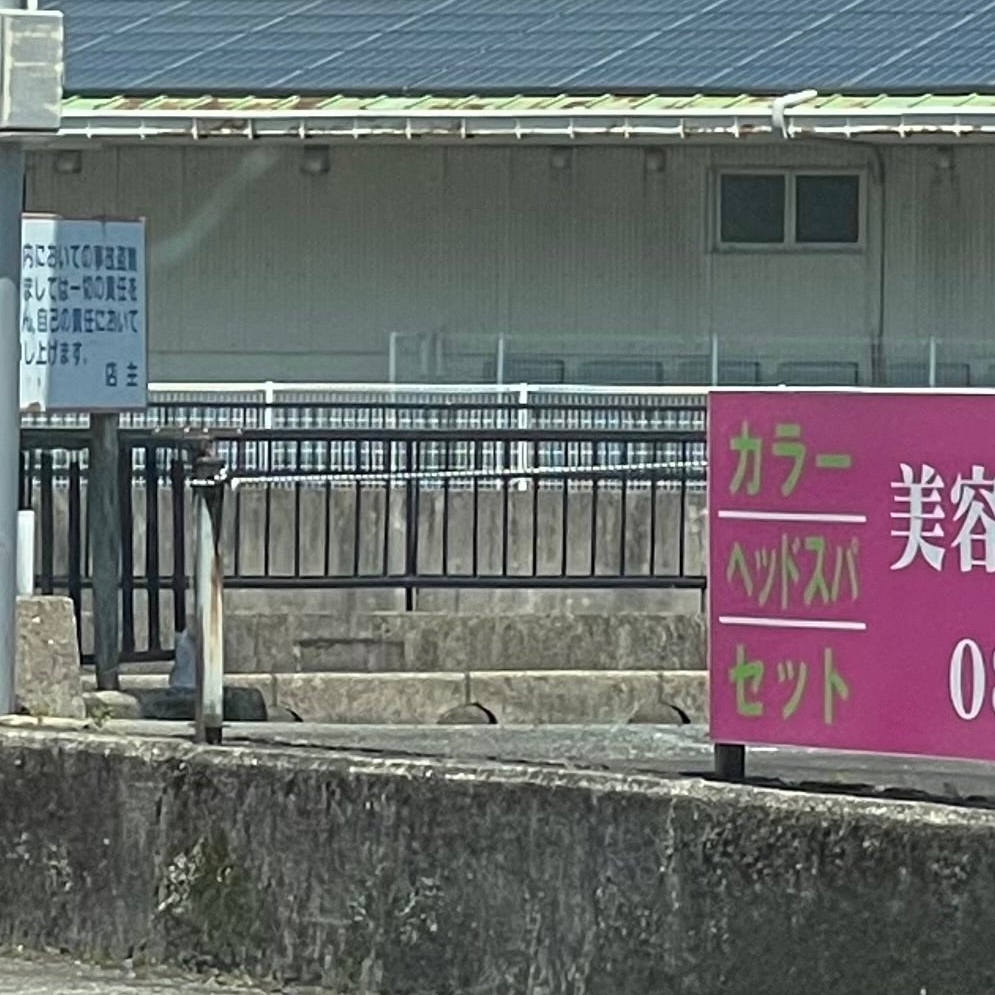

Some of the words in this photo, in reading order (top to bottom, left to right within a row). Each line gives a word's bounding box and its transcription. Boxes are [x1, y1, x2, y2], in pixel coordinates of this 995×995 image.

[727, 421, 852, 497] カラー
[726, 533, 860, 611] ヘッドスパ
[729, 643, 851, 726] セット
